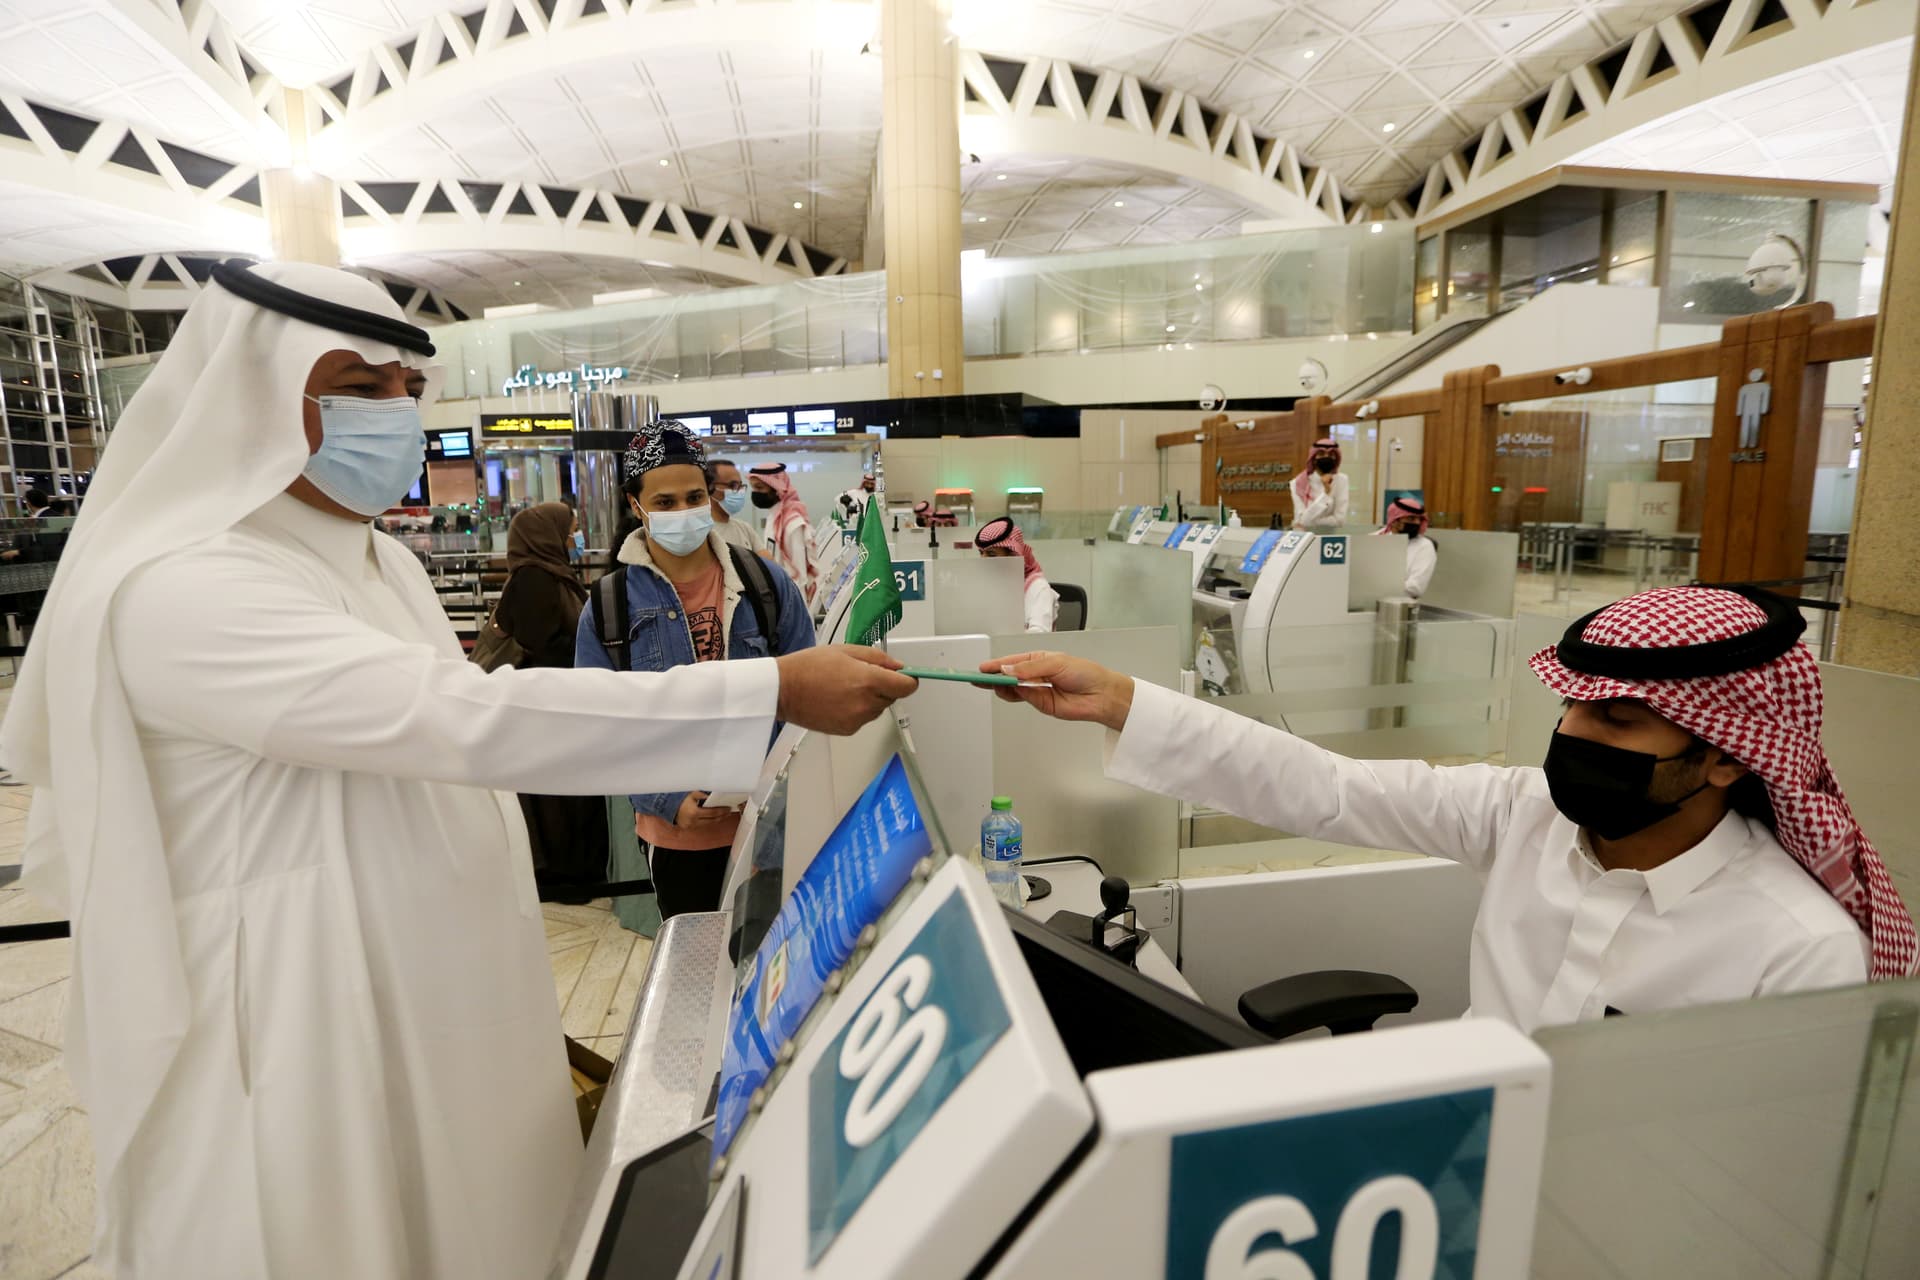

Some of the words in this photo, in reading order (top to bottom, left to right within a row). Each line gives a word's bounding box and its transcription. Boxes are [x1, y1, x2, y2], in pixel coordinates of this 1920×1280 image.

[581, 363, 624, 391] مرحبا
[712, 424, 727, 435] 211
[732, 423, 748, 434] 212
[836, 417, 854, 429] 213
[1323, 542, 1344, 559] 62
[894, 569, 918, 592] 61
[839, 953, 947, 1148] 60
[1203, 1173, 1439, 1280] 60
